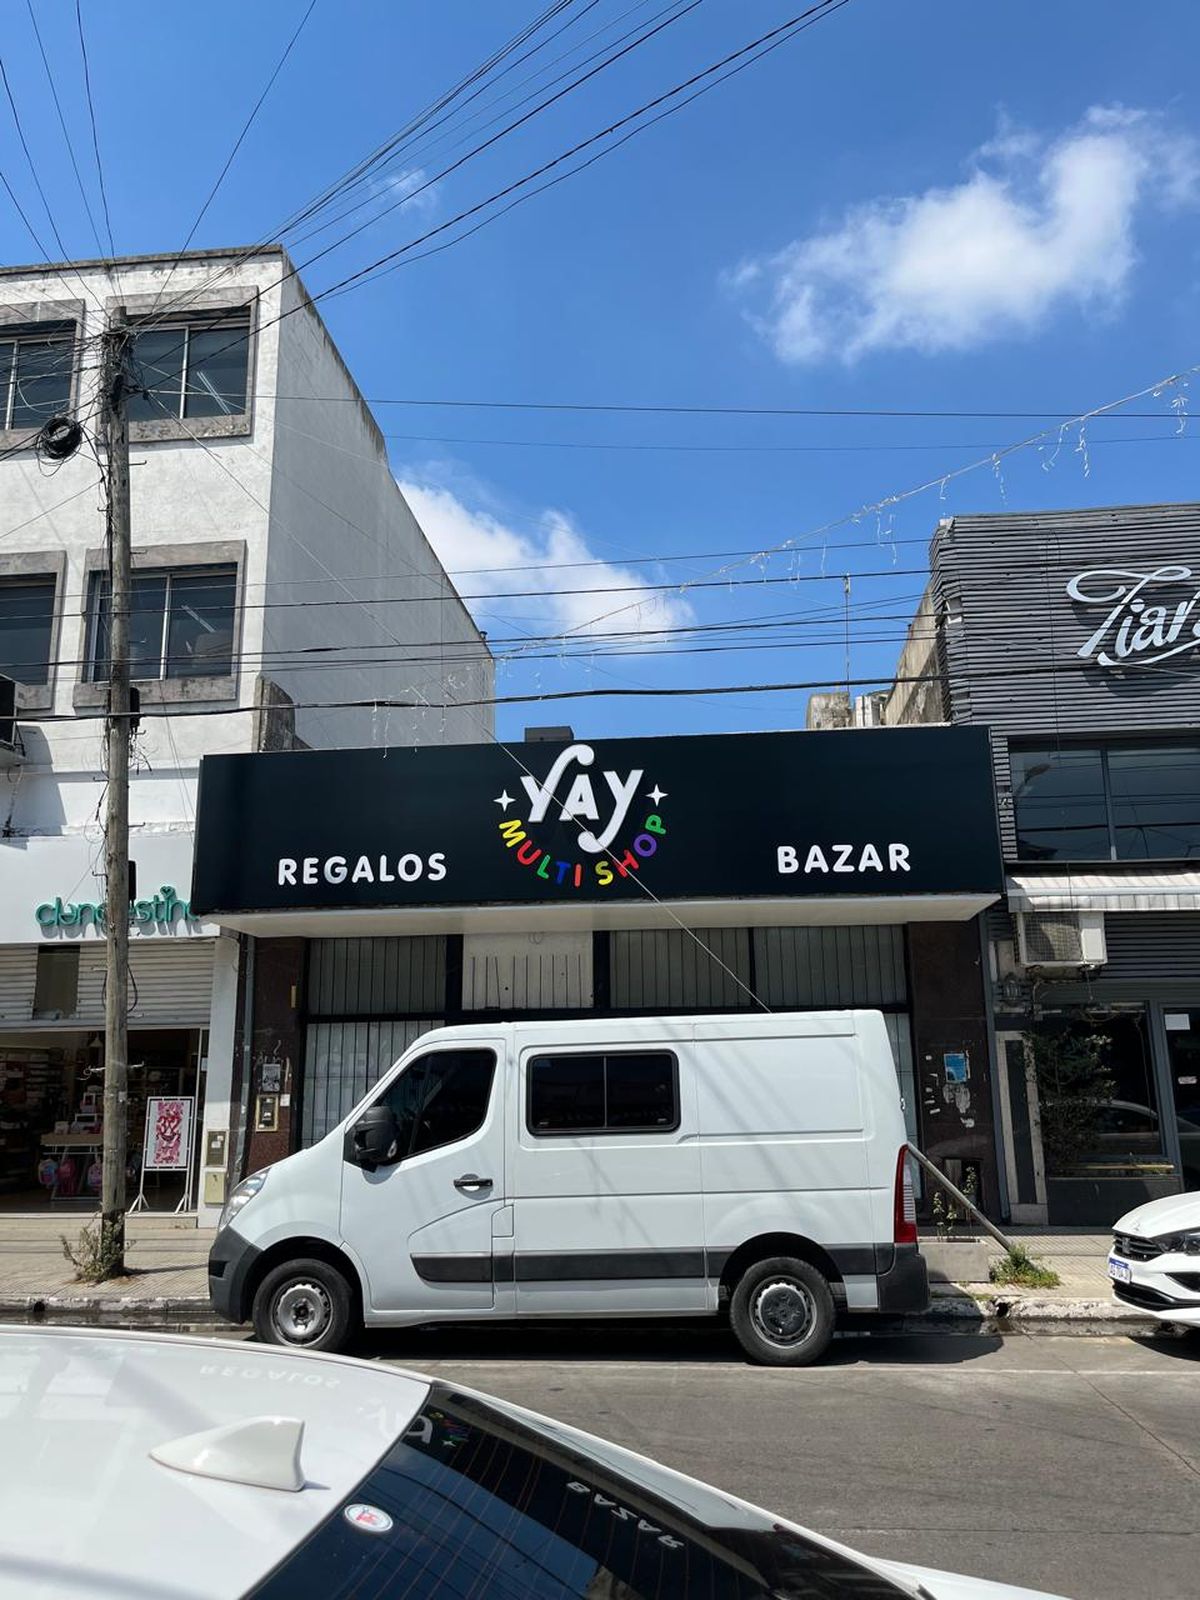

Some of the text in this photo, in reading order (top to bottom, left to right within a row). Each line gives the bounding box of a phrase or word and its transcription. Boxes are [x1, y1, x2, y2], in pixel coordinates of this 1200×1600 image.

[1066, 565, 1200, 666] Tiar
[277, 853, 447, 885] REGALOS
[499, 814, 667, 887] MULTI SHOP
[777, 843, 911, 874] BAZAR
